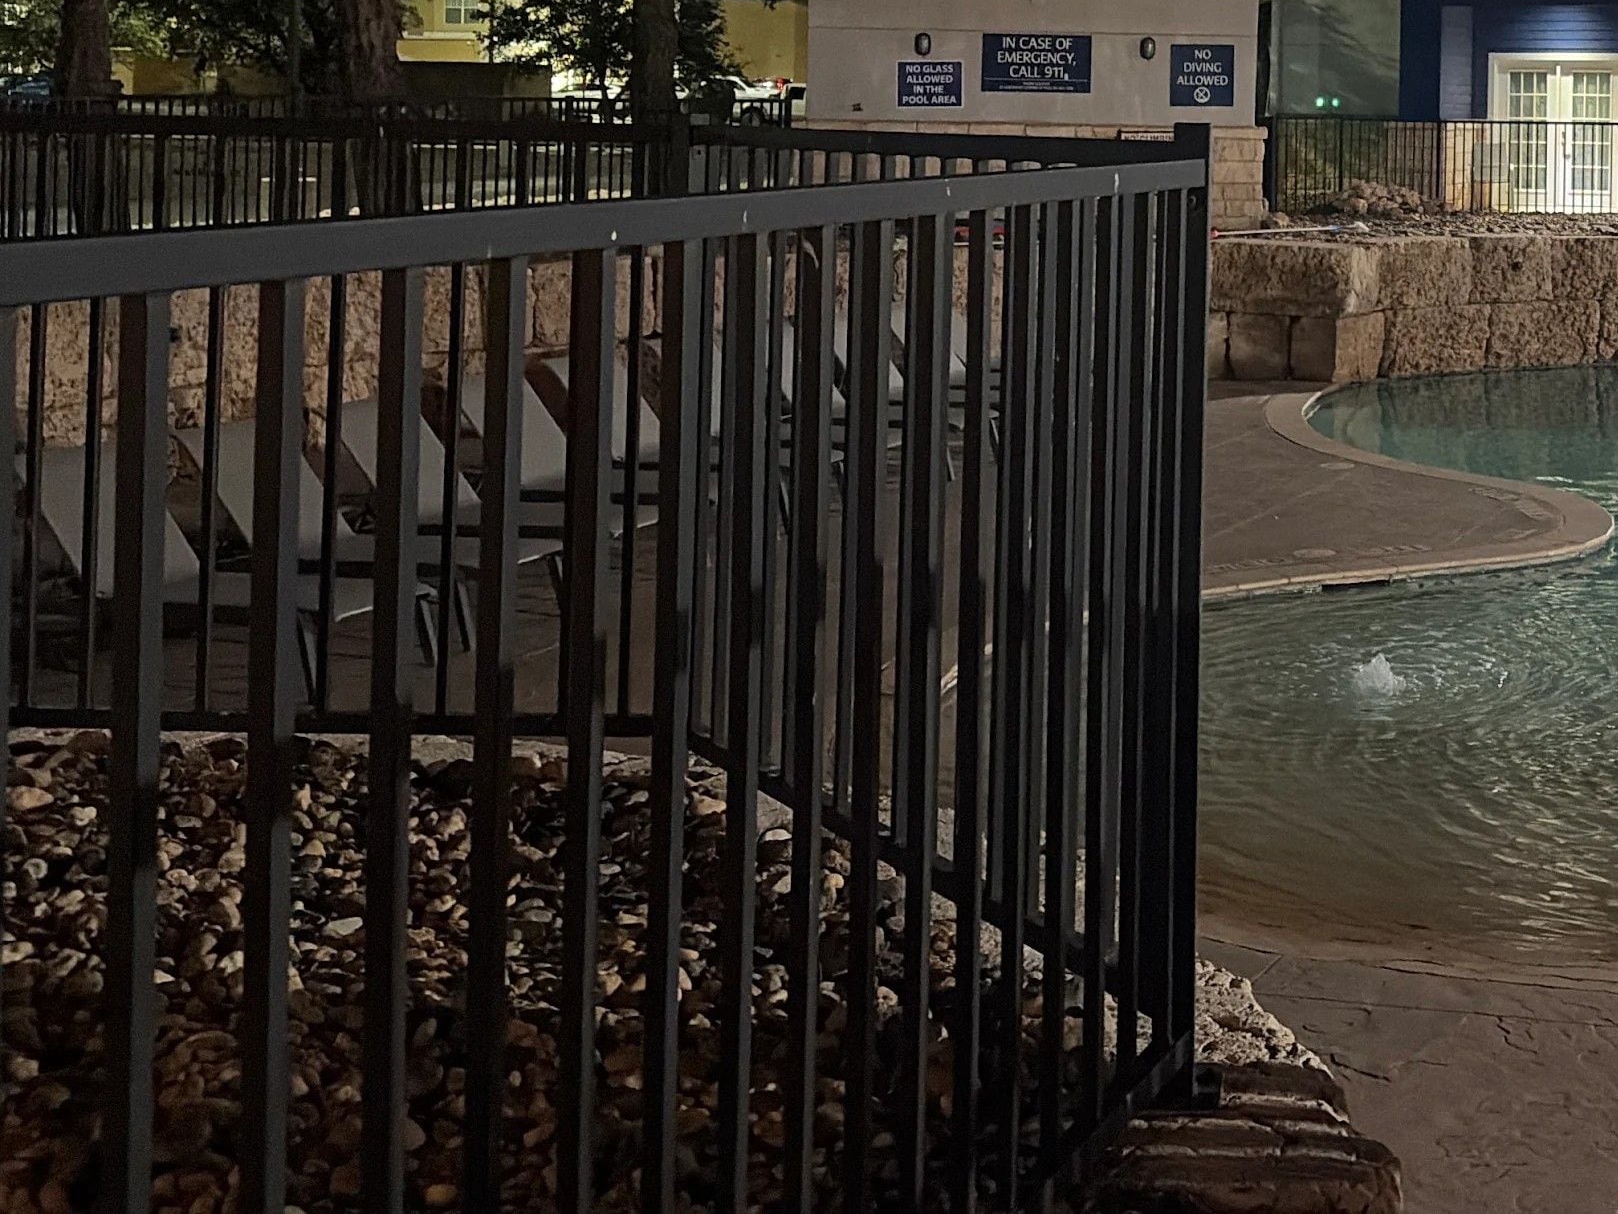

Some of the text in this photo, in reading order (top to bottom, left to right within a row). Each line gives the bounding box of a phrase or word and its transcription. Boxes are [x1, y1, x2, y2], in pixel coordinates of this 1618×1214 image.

[1002, 36, 1073, 50] IN CASE OF
[997, 50, 1076, 66] EMERGENCY,
[1194, 49, 1212, 60] NO
[906, 64, 954, 73] NO GLASS
[1009, 65, 1041, 78] CALL
[1183, 62, 1222, 73] DIVING
[906, 74, 954, 84] ALLOWED
[1176, 75, 1229, 86] ALLOWED
[912, 85, 944, 94] IN THE
[902, 95, 957, 104] POOL AREA
